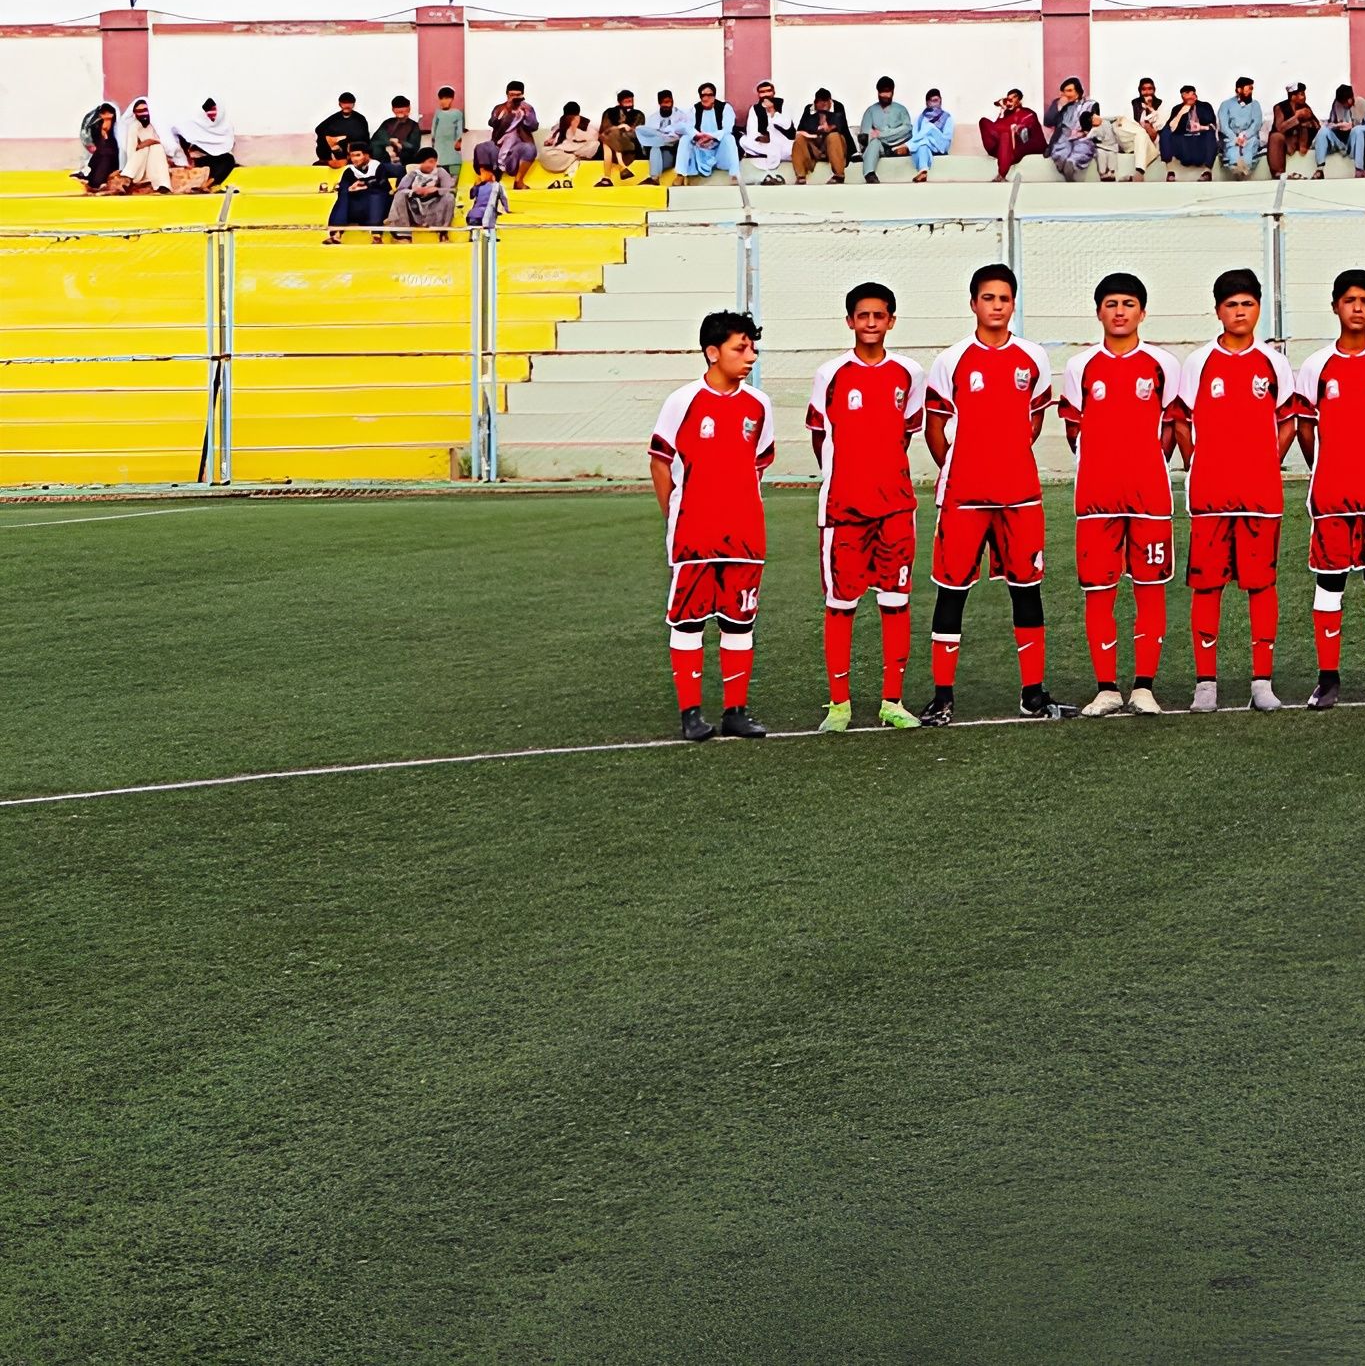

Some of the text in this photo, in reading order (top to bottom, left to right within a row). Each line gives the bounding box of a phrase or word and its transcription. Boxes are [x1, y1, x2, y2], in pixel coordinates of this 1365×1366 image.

[1145, 542, 1165, 565] 15
[898, 565, 909, 587] 8
[740, 587, 757, 612] 16
